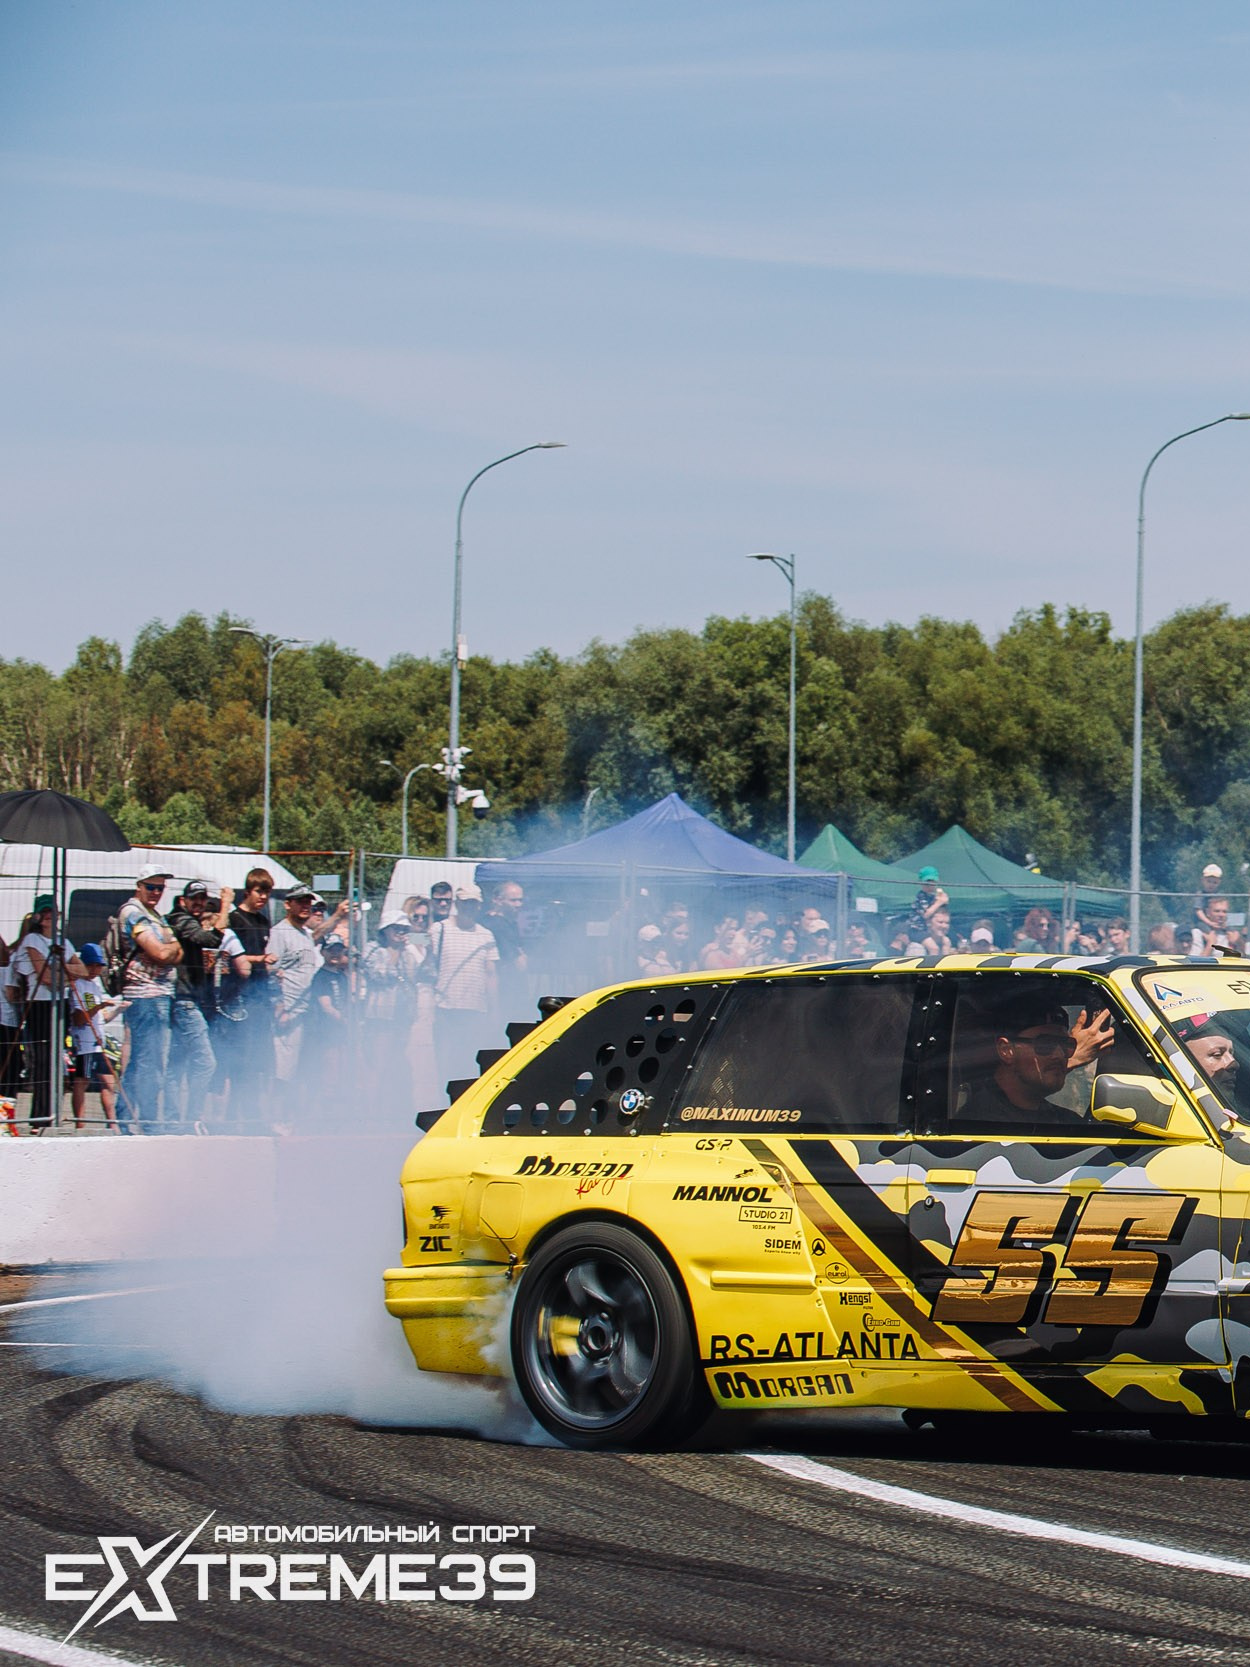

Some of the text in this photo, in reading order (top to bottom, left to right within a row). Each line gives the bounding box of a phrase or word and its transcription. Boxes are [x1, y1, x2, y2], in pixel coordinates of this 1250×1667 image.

[681, 1106, 801, 1122] @MAXIMUM39
[672, 1185, 773, 1203] MANNOL
[744, 1209, 789, 1220] STUDIO 21
[419, 1236, 453, 1252] ZIC
[764, 1239, 801, 1250] SIDEM
[839, 1292, 872, 1306] Hengst
[710, 1331, 920, 1359] RS-ATLANTA
